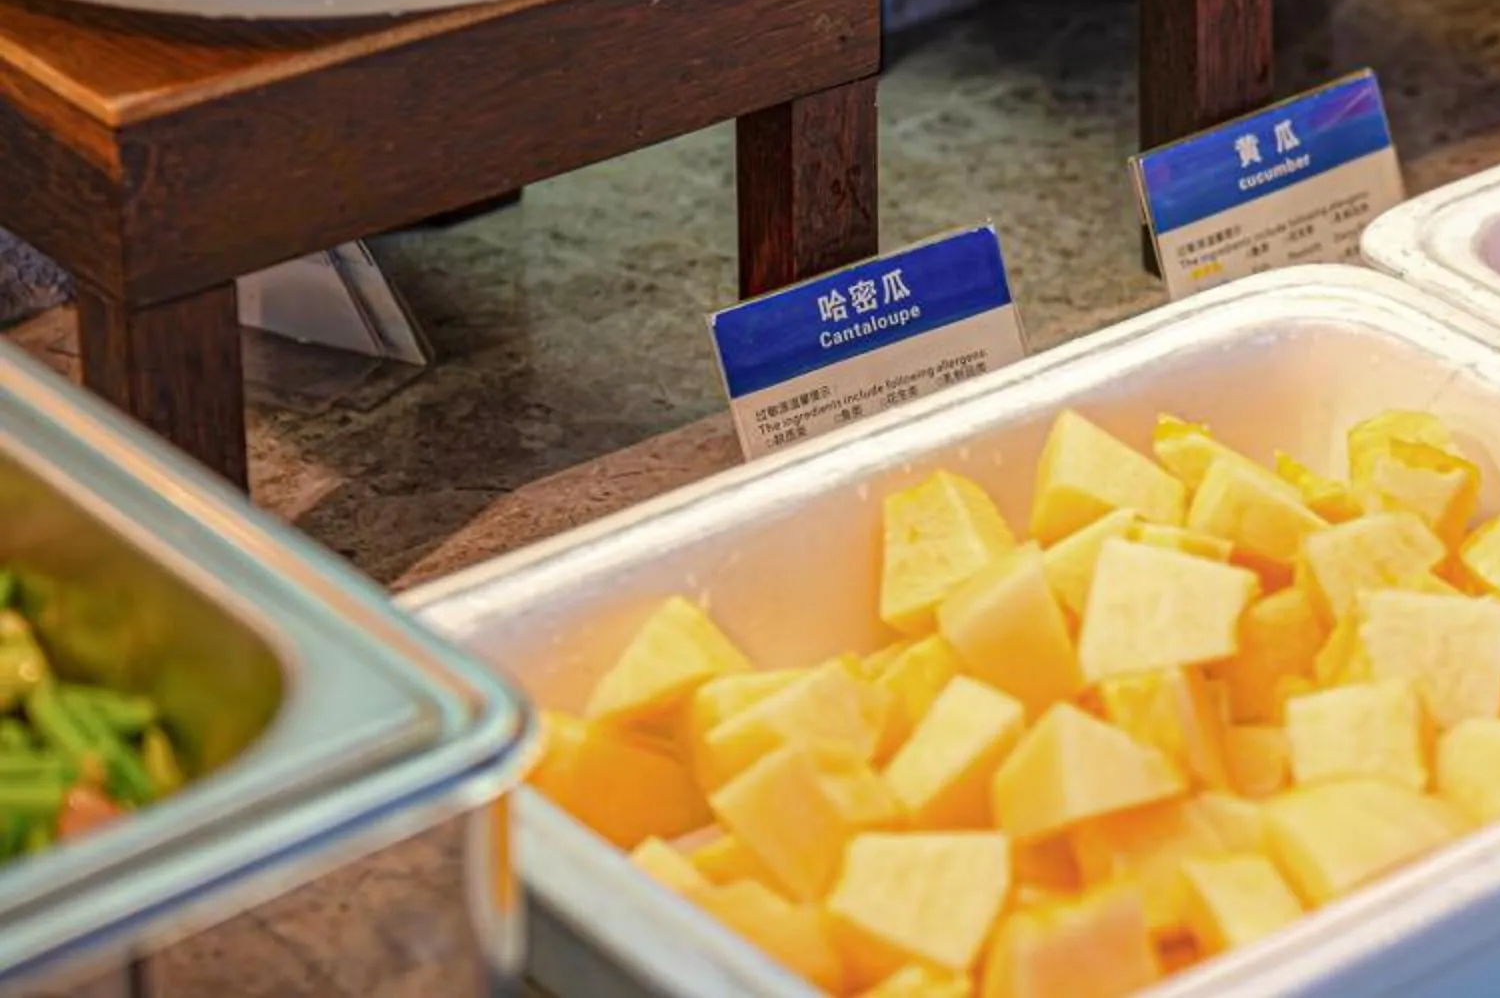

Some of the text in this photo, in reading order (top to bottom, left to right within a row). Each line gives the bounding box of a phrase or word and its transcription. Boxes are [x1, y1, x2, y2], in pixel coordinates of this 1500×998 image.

[1234, 118, 1300, 168] 黄瓜
[1238, 153, 1312, 191] cucumber
[816, 268, 911, 323] 哈密瓜
[819, 304, 921, 349] Cantaloupe
[844, 385, 883, 404] include
